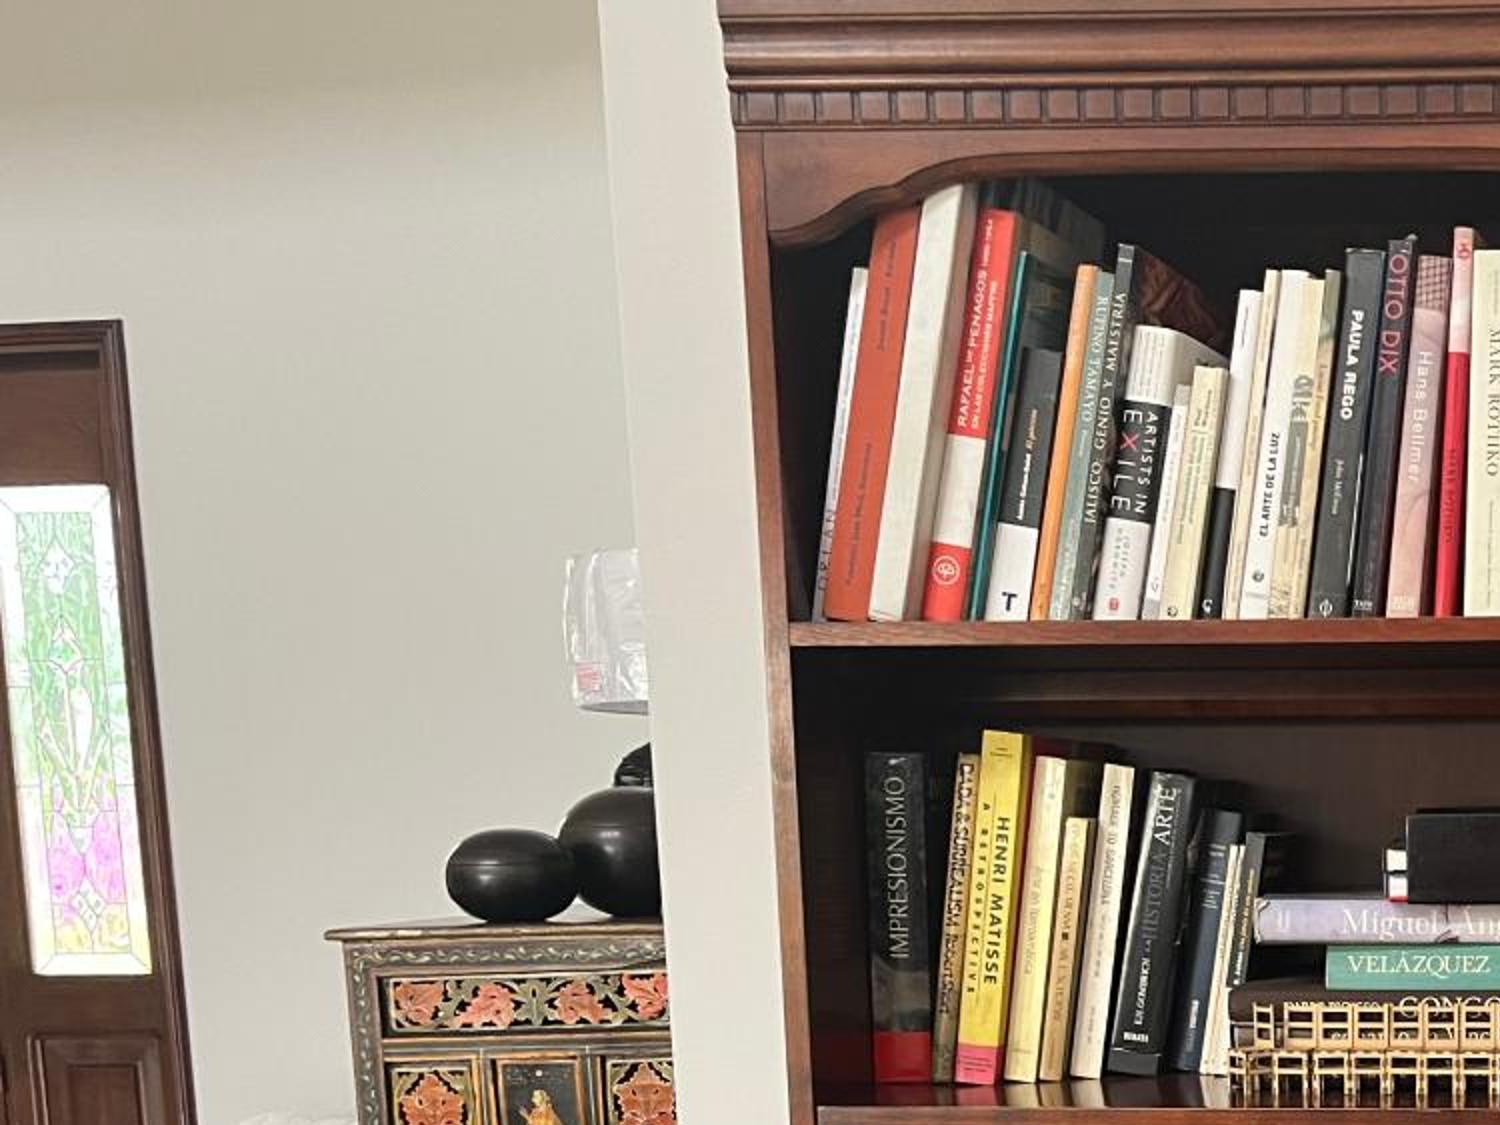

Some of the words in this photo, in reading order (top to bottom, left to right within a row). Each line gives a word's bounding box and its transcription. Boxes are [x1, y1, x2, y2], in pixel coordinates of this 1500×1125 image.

[1384, 255, 1407, 320] OTTO
[958, 364, 975, 427] RAFAEL
[969, 270, 987, 347] PENAGOS
[1088, 296, 1108, 353] RUFINO
[1346, 310, 1364, 365] PAULA
[1379, 330, 1399, 373] DIX
[1414, 351, 1433, 401] Hans
[974, 395, 983, 413] LAS
[1080, 359, 1100, 422] TAMAYO
[1102, 379, 1113, 388] Y
[1341, 372, 1357, 420] REGO
[1094, 398, 1111, 449] GENIO
[1138, 411, 1160, 485] ARTISTS
[1269, 432, 1280, 453] LUZ
[1408, 409, 1428, 483] Bellmer
[1111, 409, 1142, 511] EXILE
[1265, 472, 1275, 489] DE
[1267, 456, 1278, 470] LA
[1134, 493, 1150, 514] IN
[1261, 491, 1273, 521] ARTE
[1259, 523, 1269, 537] EL
[958, 763, 974, 809] DADA
[958, 813, 972, 826] &
[1107, 832, 1117, 846] TO
[884, 777, 910, 958] IMPRESIONISMO
[993, 817, 1011, 883] HENRI
[1143, 852, 1164, 939] HISTORIA
[1154, 787, 1177, 845] ARTE
[946, 827, 970, 927] SURREALISM
[1100, 849, 1116, 905] BARCELONA
[967, 828, 989, 993] RETROSPECTIVE
[1342, 908, 1442, 938] Miguel
[944, 933, 959, 974] Robert
[984, 893, 1004, 985] MATISSE
[1347, 955, 1491, 979] VELÁZQUEZ
